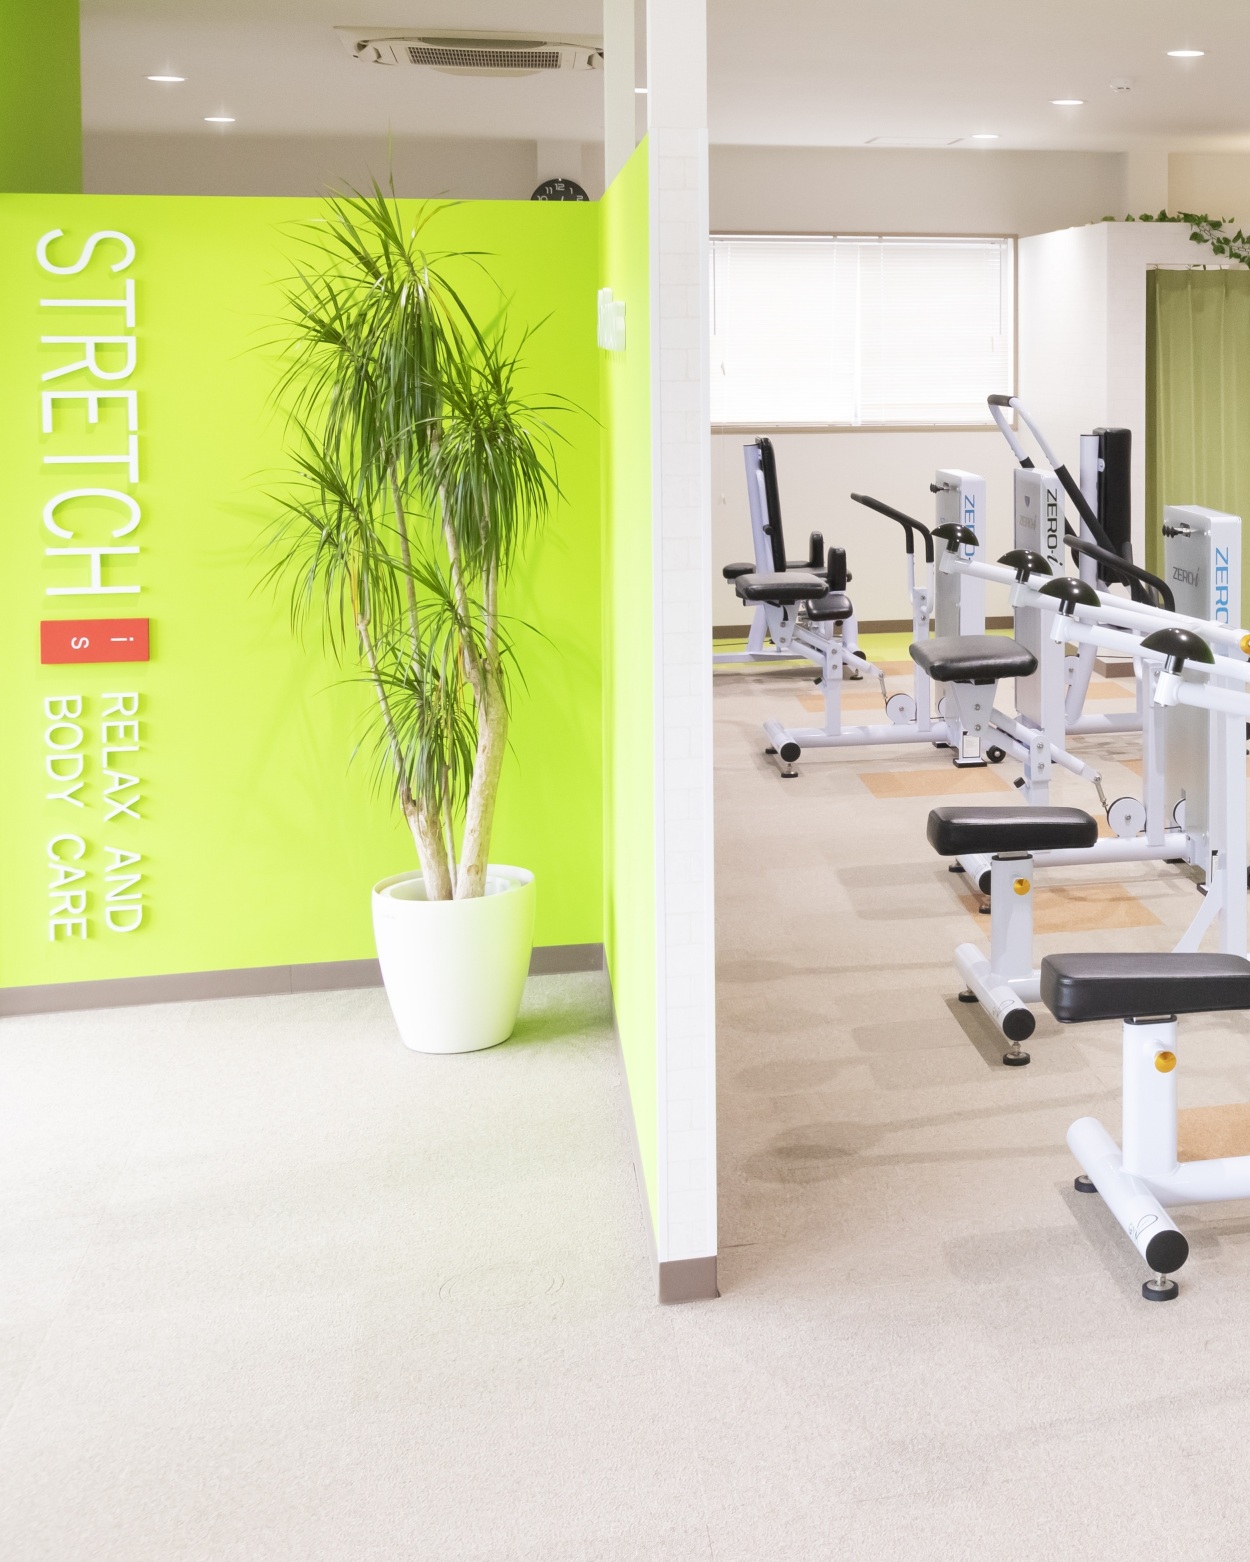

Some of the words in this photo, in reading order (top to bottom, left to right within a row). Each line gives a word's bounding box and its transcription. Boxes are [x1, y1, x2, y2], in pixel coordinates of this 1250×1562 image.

[545, 186, 553, 194] 11
[554, 183, 565, 191] 12
[36, 229, 141, 595] STRETCH
[964, 494, 975, 561] ZEO-
[1215, 547, 1229, 625] ZERO
[44, 694, 85, 808] BODY
[101, 691, 141, 822] RELAX
[47, 833, 87, 942] CARE
[104, 846, 143, 933] AND
